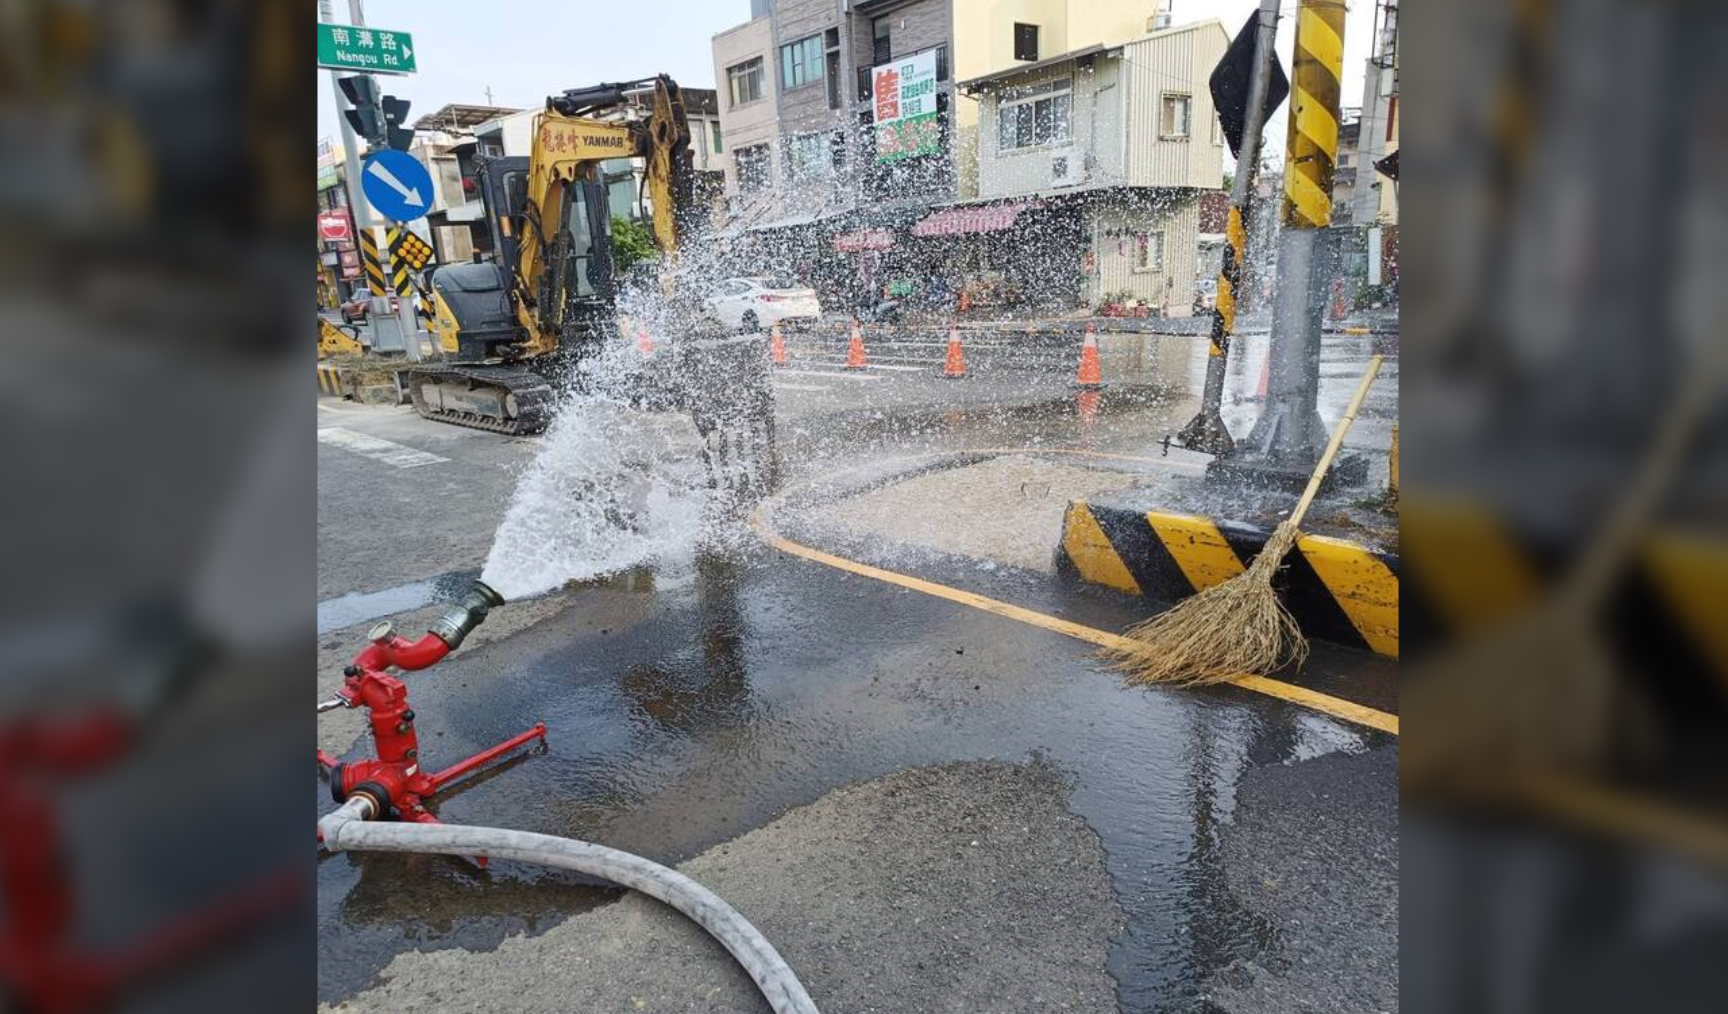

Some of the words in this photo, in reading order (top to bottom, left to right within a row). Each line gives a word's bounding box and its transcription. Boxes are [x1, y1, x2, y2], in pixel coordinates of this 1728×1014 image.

[331, 27, 397, 50] 南溝路
[336, 49, 377, 66] Nangou
[875, 69, 900, 121] 售
[582, 135, 625, 149] YANMAR
